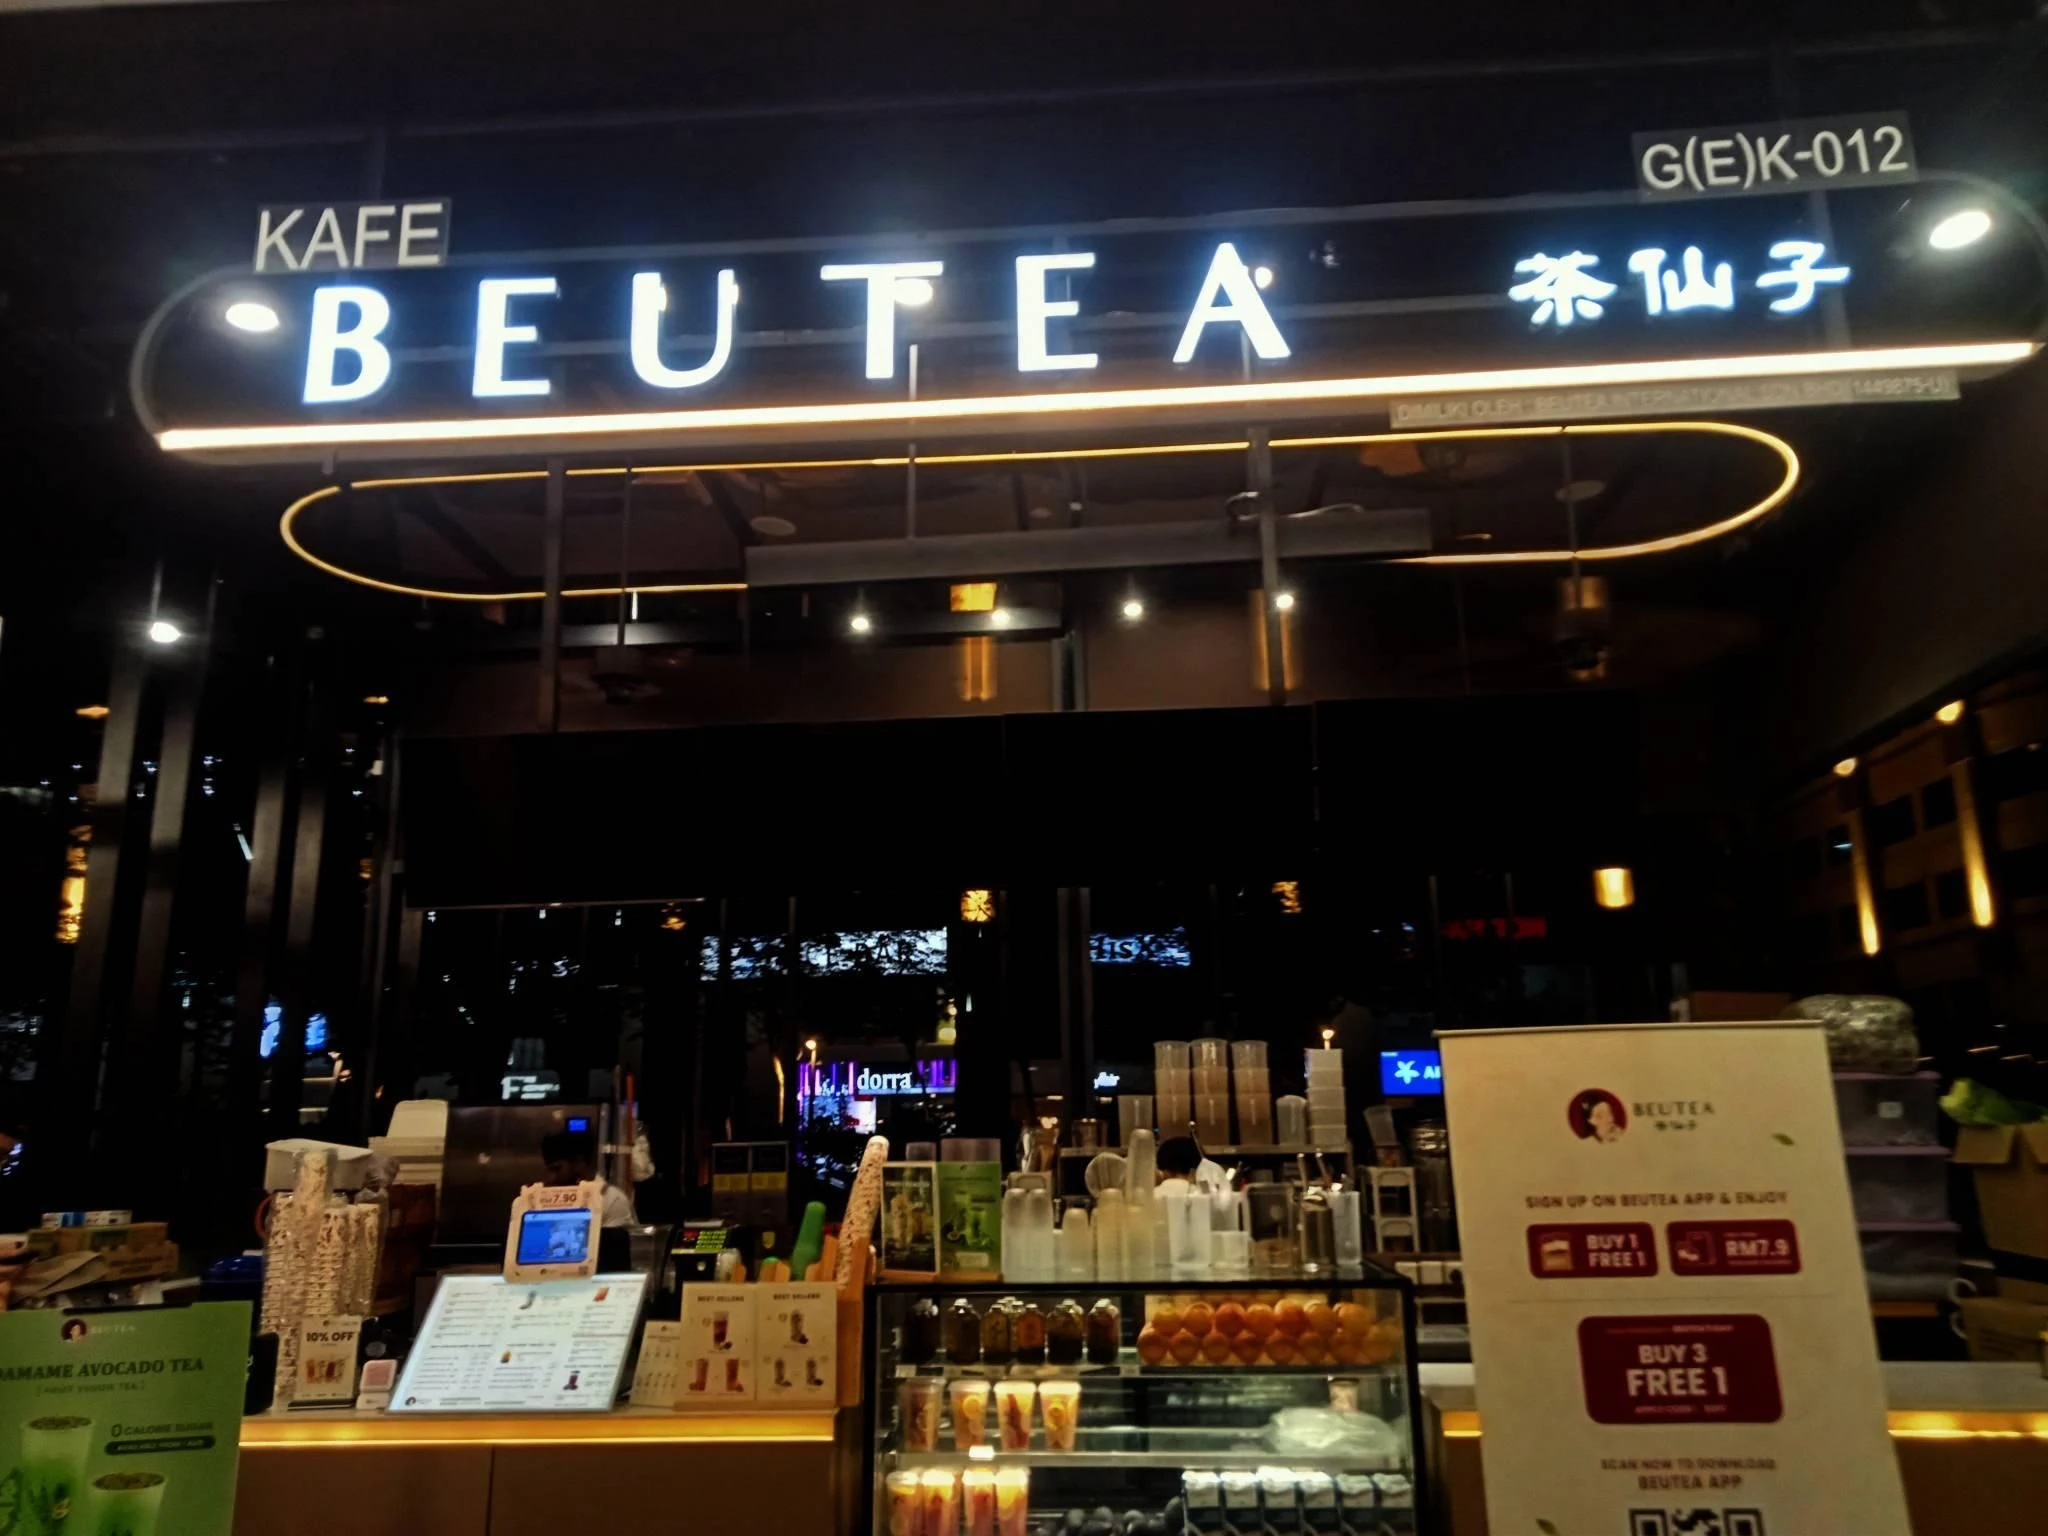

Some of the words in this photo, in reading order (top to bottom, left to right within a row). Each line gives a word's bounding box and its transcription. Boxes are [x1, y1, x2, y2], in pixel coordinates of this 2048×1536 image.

[1641, 125, 1909, 193] G(E)K-012
[255, 202, 444, 272] KAFE
[1508, 241, 1852, 328] 茶仙子
[302, 242, 1292, 404] BEUTEA
[857, 1067, 912, 1089] dorra
[1633, 1101, 1715, 1117] BEUTEA
[1525, 1196, 1562, 1208] SIGN
[1566, 1195, 1588, 1207] UP
[1592, 1194, 1616, 1206] ON
[1620, 1193, 1677, 1206] BEUTEA
[1684, 1193, 1714, 1205] APP
[1719, 1193, 1732, 1205] &
[1736, 1191, 1788, 1204] ENJOY
[1586, 1234, 1624, 1250] BUY
[1628, 1233, 1639, 1249] 1
[1725, 1239, 1791, 1257] RM7.9
[1589, 1252, 1633, 1267] FREE
[1636, 1251, 1647, 1267] 1
[306, 1331, 328, 1342] 10%
[331, 1331, 353, 1342] OFF
[1638, 1344, 1687, 1364] BUY
[1691, 1342, 1708, 1363] 3
[78, 1359, 164, 1377] AVOCADO
[169, 1357, 205, 1373] TEA
[1626, 1368, 1708, 1396] FREE
[1712, 1366, 1729, 1395] 1
[1637, 1475, 1703, 1490] BEUTEA
[1709, 1474, 1743, 1489] APP
